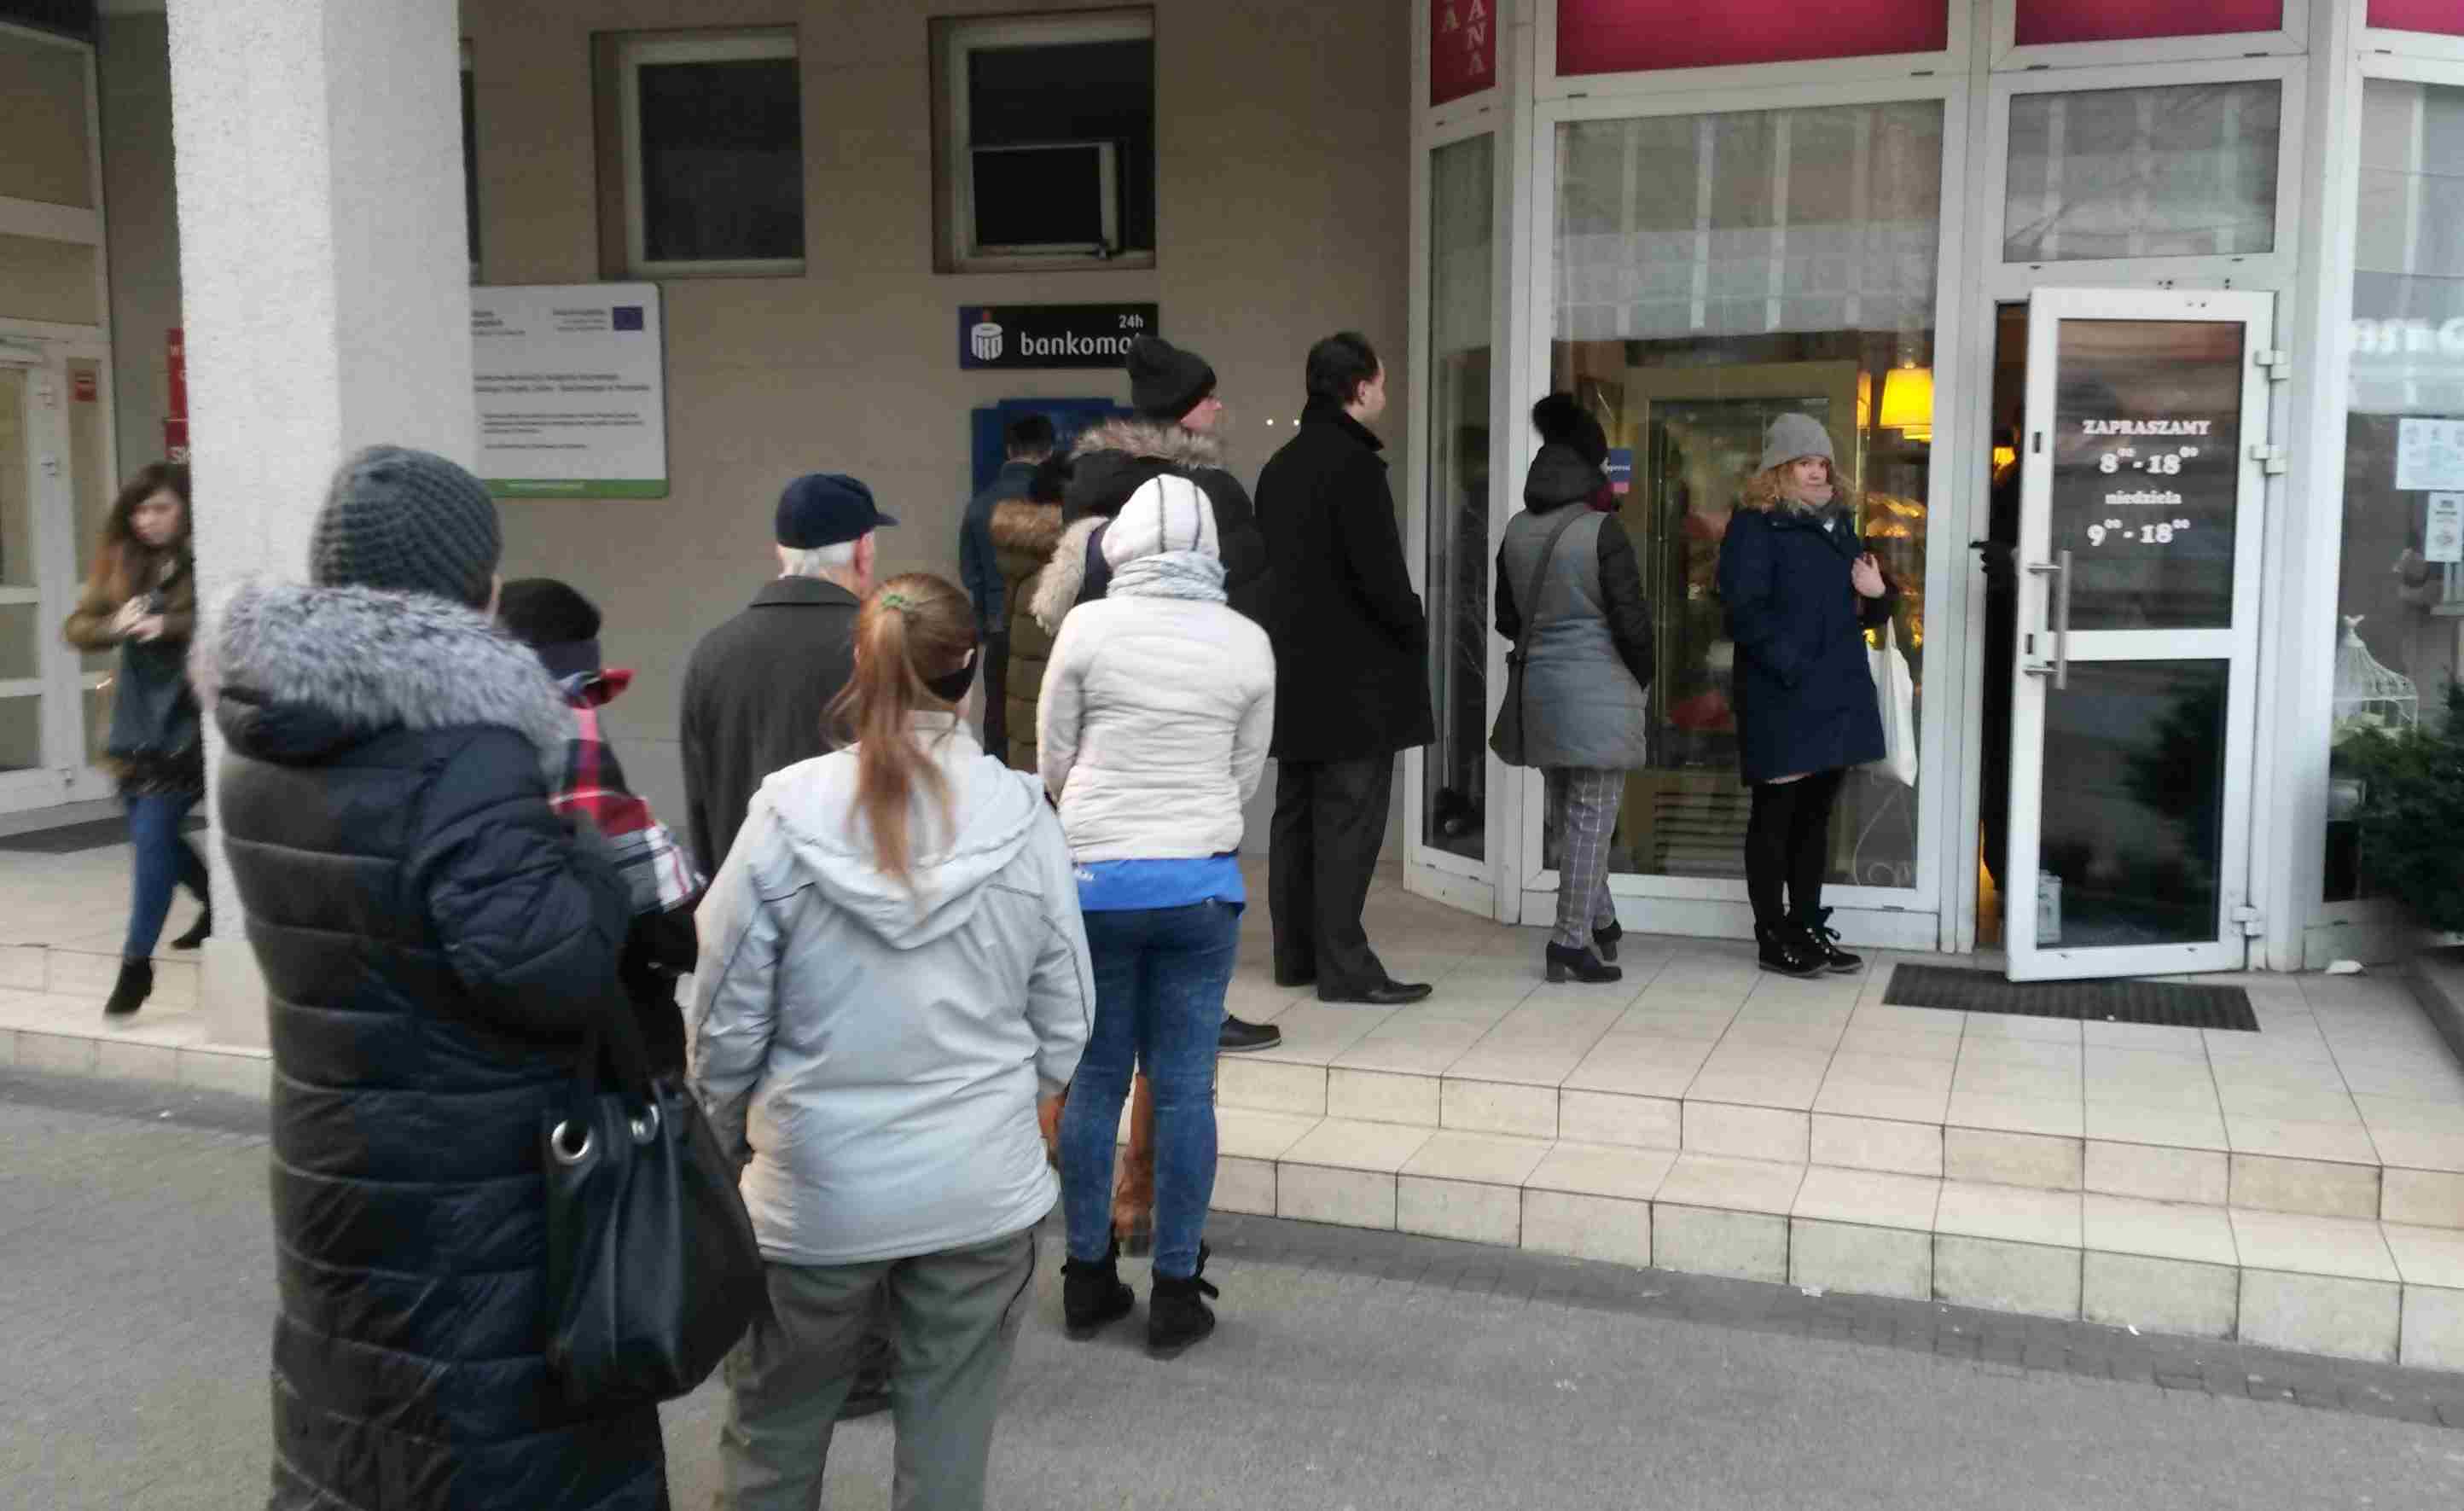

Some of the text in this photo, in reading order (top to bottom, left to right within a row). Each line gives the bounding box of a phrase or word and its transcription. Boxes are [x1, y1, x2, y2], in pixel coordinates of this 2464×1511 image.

[1119, 314, 1144, 328] 24h
[1020, 330, 1140, 356] bankoma
[2105, 490, 2182, 504] niedziela
